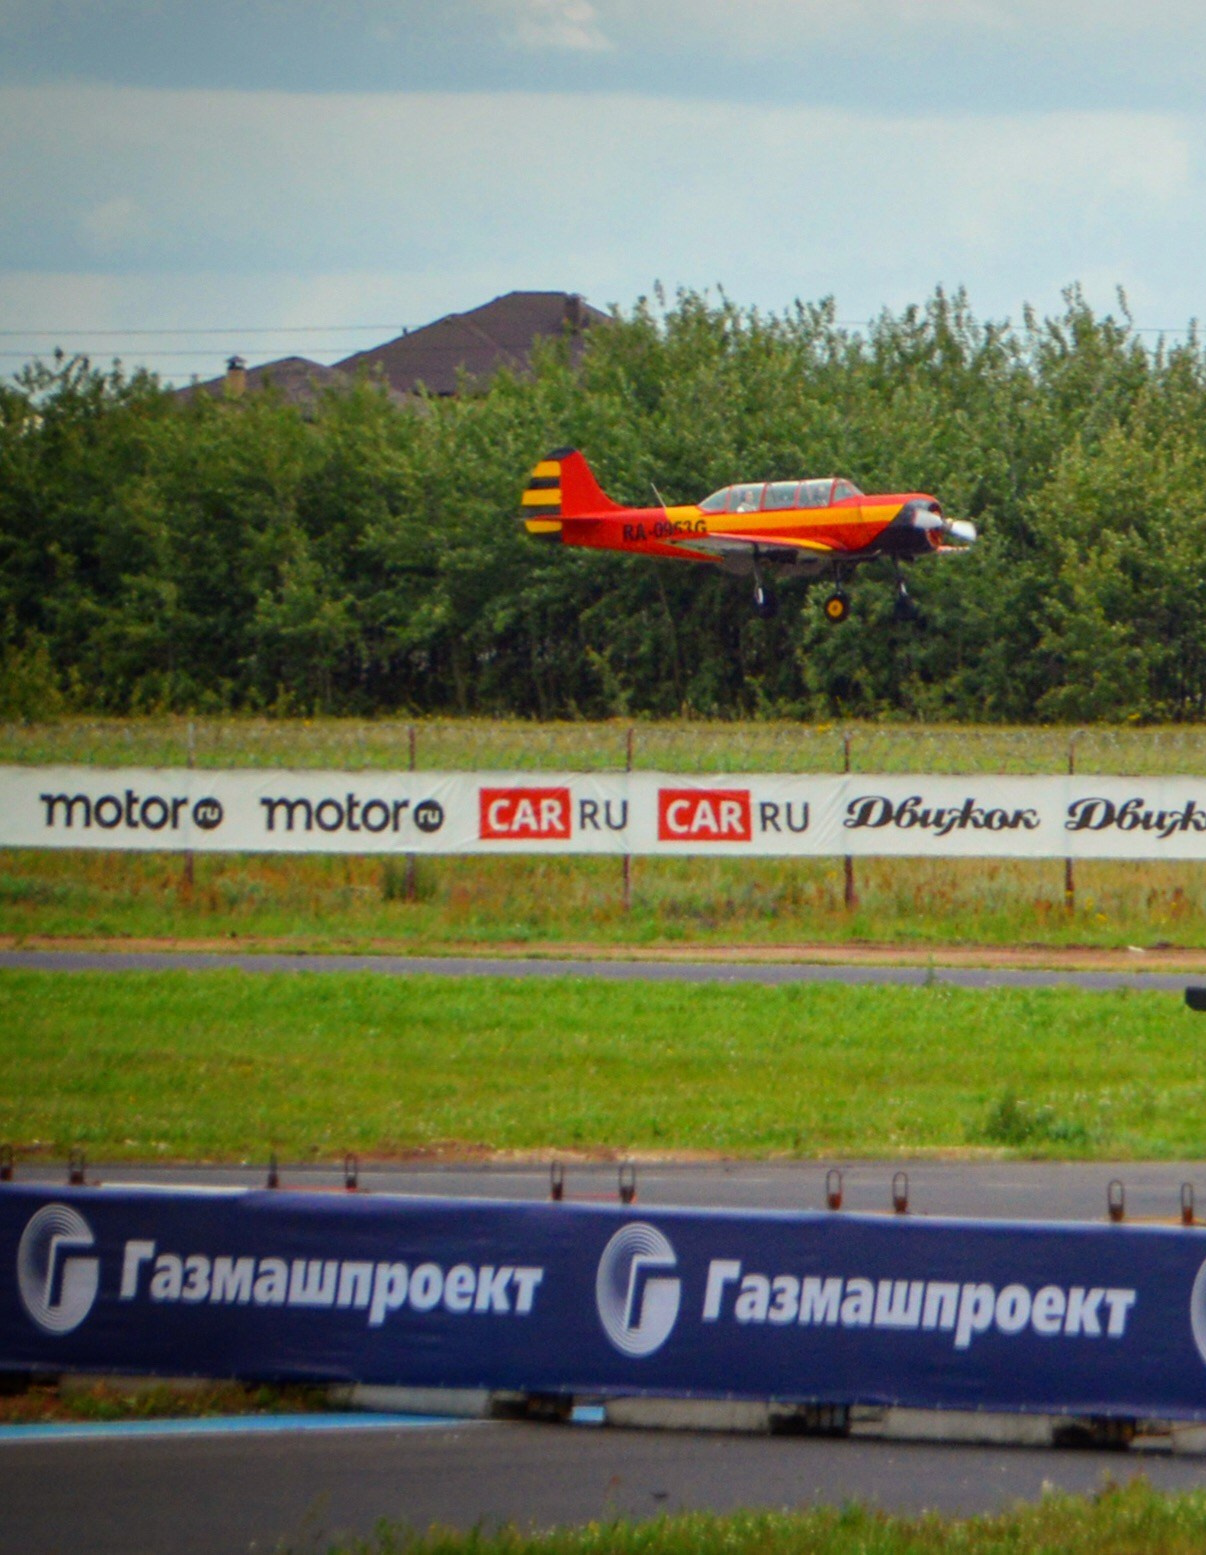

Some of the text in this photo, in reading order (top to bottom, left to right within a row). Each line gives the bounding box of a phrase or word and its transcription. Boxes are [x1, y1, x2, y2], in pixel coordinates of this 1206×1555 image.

[40, 791, 188, 829] motor
[260, 793, 409, 832] motor
[487, 798, 629, 832] CAR RU
[665, 799, 809, 833] CAR RU
[843, 794, 1040, 836] Движок
[119, 1240, 544, 1326] Газмашпроект
[702, 1259, 1136, 1350] Газмашпроект
